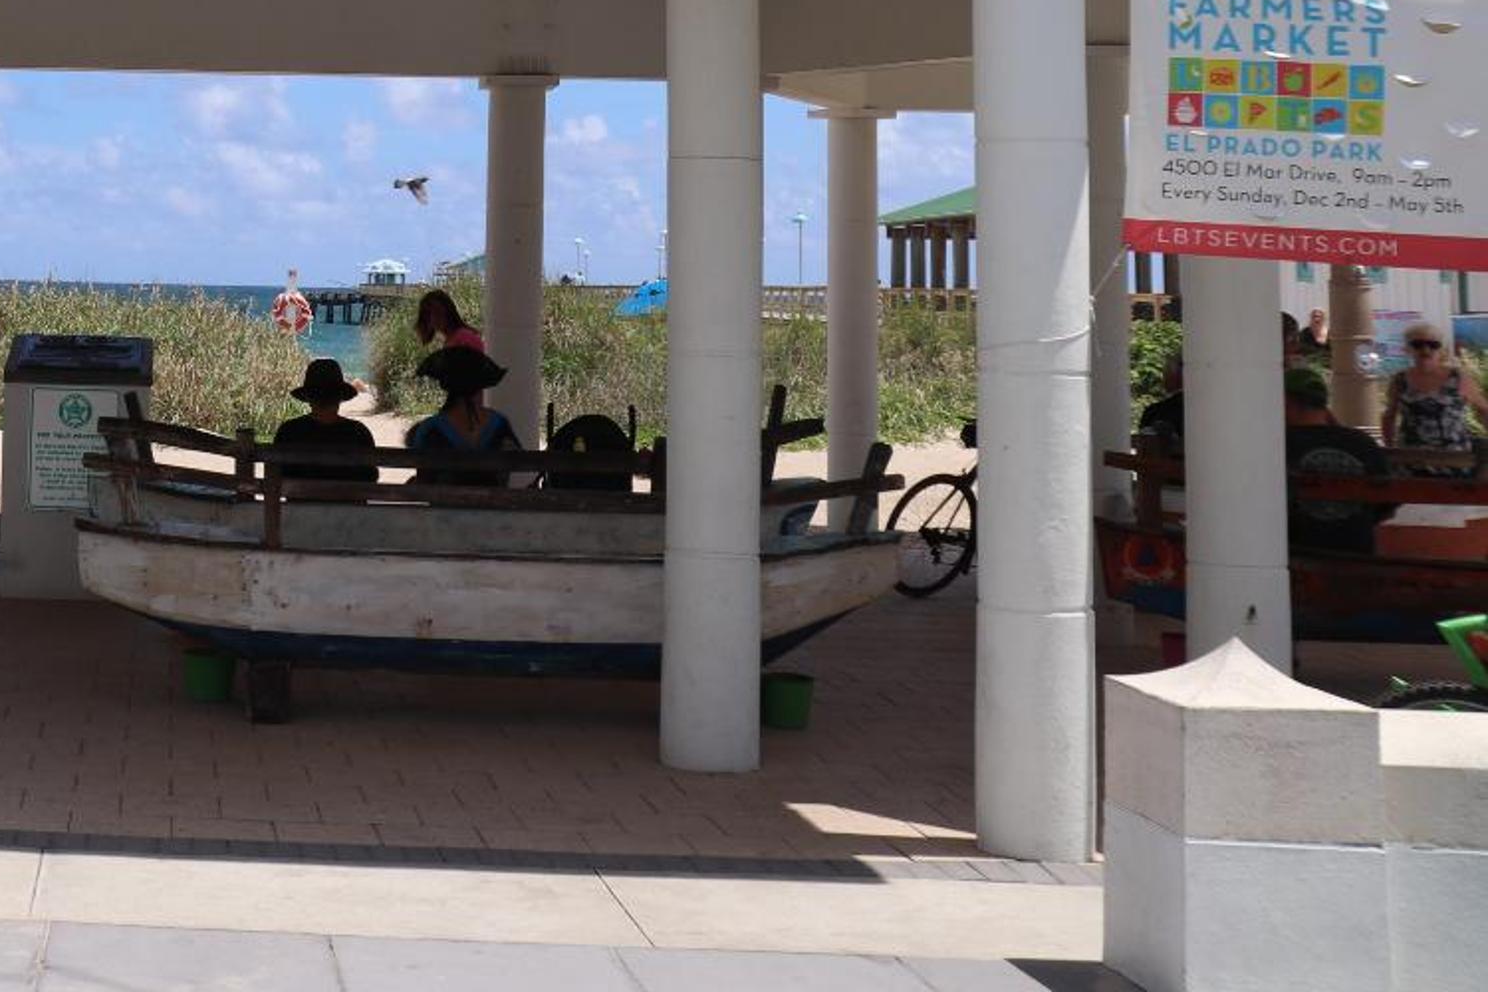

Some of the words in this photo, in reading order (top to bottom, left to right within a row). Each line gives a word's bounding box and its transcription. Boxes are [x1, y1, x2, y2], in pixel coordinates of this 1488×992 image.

[1168, 21, 1387, 58] MARKET
[1165, 134, 1196, 153] EL
[1206, 136, 1302, 158] PRADO
[1311, 140, 1383, 162] PARK
[1161, 158, 1218, 176] 4500
[1223, 160, 1241, 178] El
[1246, 164, 1283, 180] Mar
[1352, 167, 1394, 185] 9am
[1411, 170, 1453, 191] 2pm
[1161, 181, 1212, 203] Every
[1293, 189, 1329, 207] Dec
[1333, 191, 1370, 209] 2nd
[1388, 195, 1428, 215] May
[1432, 197, 1465, 214] 5th
[1157, 225, 1399, 257] LBTSEVENTS.COM
